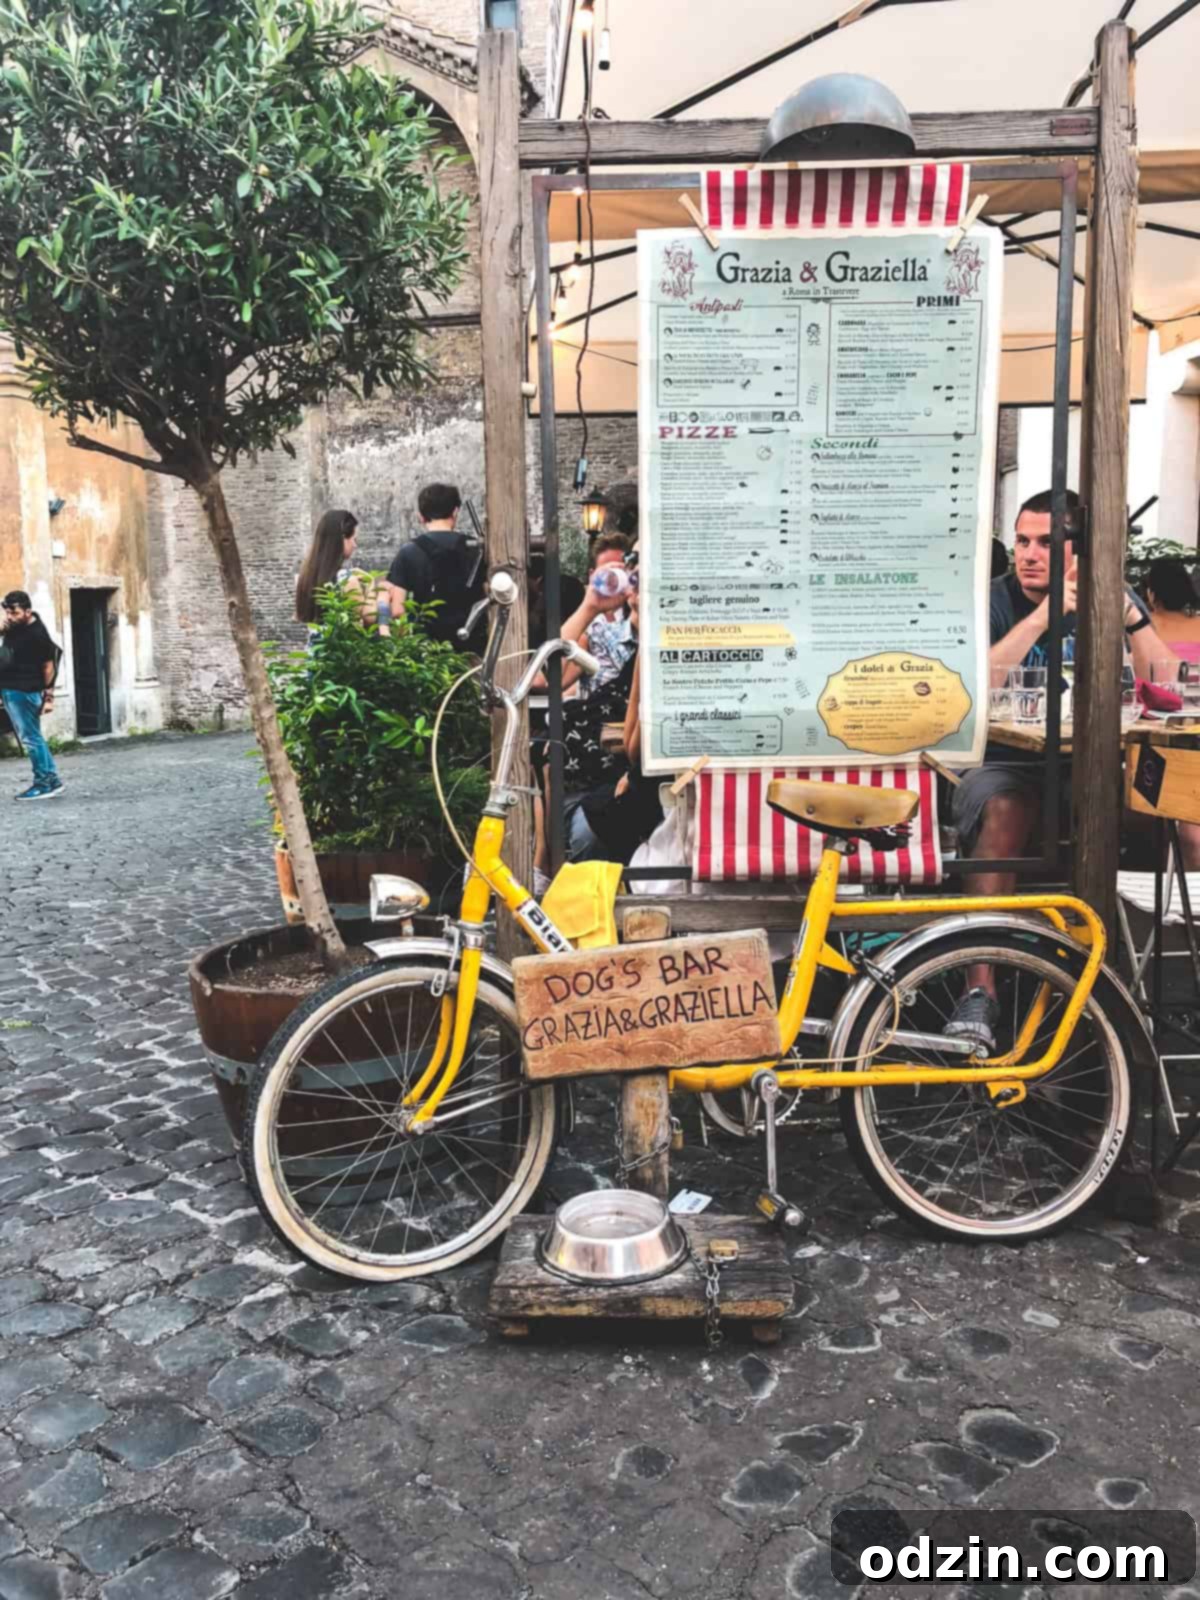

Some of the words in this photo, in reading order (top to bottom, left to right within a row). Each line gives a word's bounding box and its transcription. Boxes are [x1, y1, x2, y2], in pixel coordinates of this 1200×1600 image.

[716, 252, 792, 284] Grazia
[800, 261, 818, 283] &
[825, 251, 929, 283] Graziella
[788, 287, 811, 296] Roma
[689, 299, 744, 315] Antipasti
[916, 295, 961, 307] PRIMI
[658, 426, 738, 439] PIZZE
[810, 437, 879, 450] Secondi
[809, 574, 825, 585] LE
[834, 572, 919, 585] INSALATONE
[689, 595, 722, 606] tagliere
[725, 594, 760, 606] genuino
[660, 650, 678, 663] AL
[682, 649, 763, 663] CARTOCCIO
[861, 664, 884, 673] dolci
[900, 660, 934, 673] Grazia
[680, 710, 709, 727] grandi
[544, 957, 642, 1004] DOG'S
[658, 947, 729, 985] BAR
